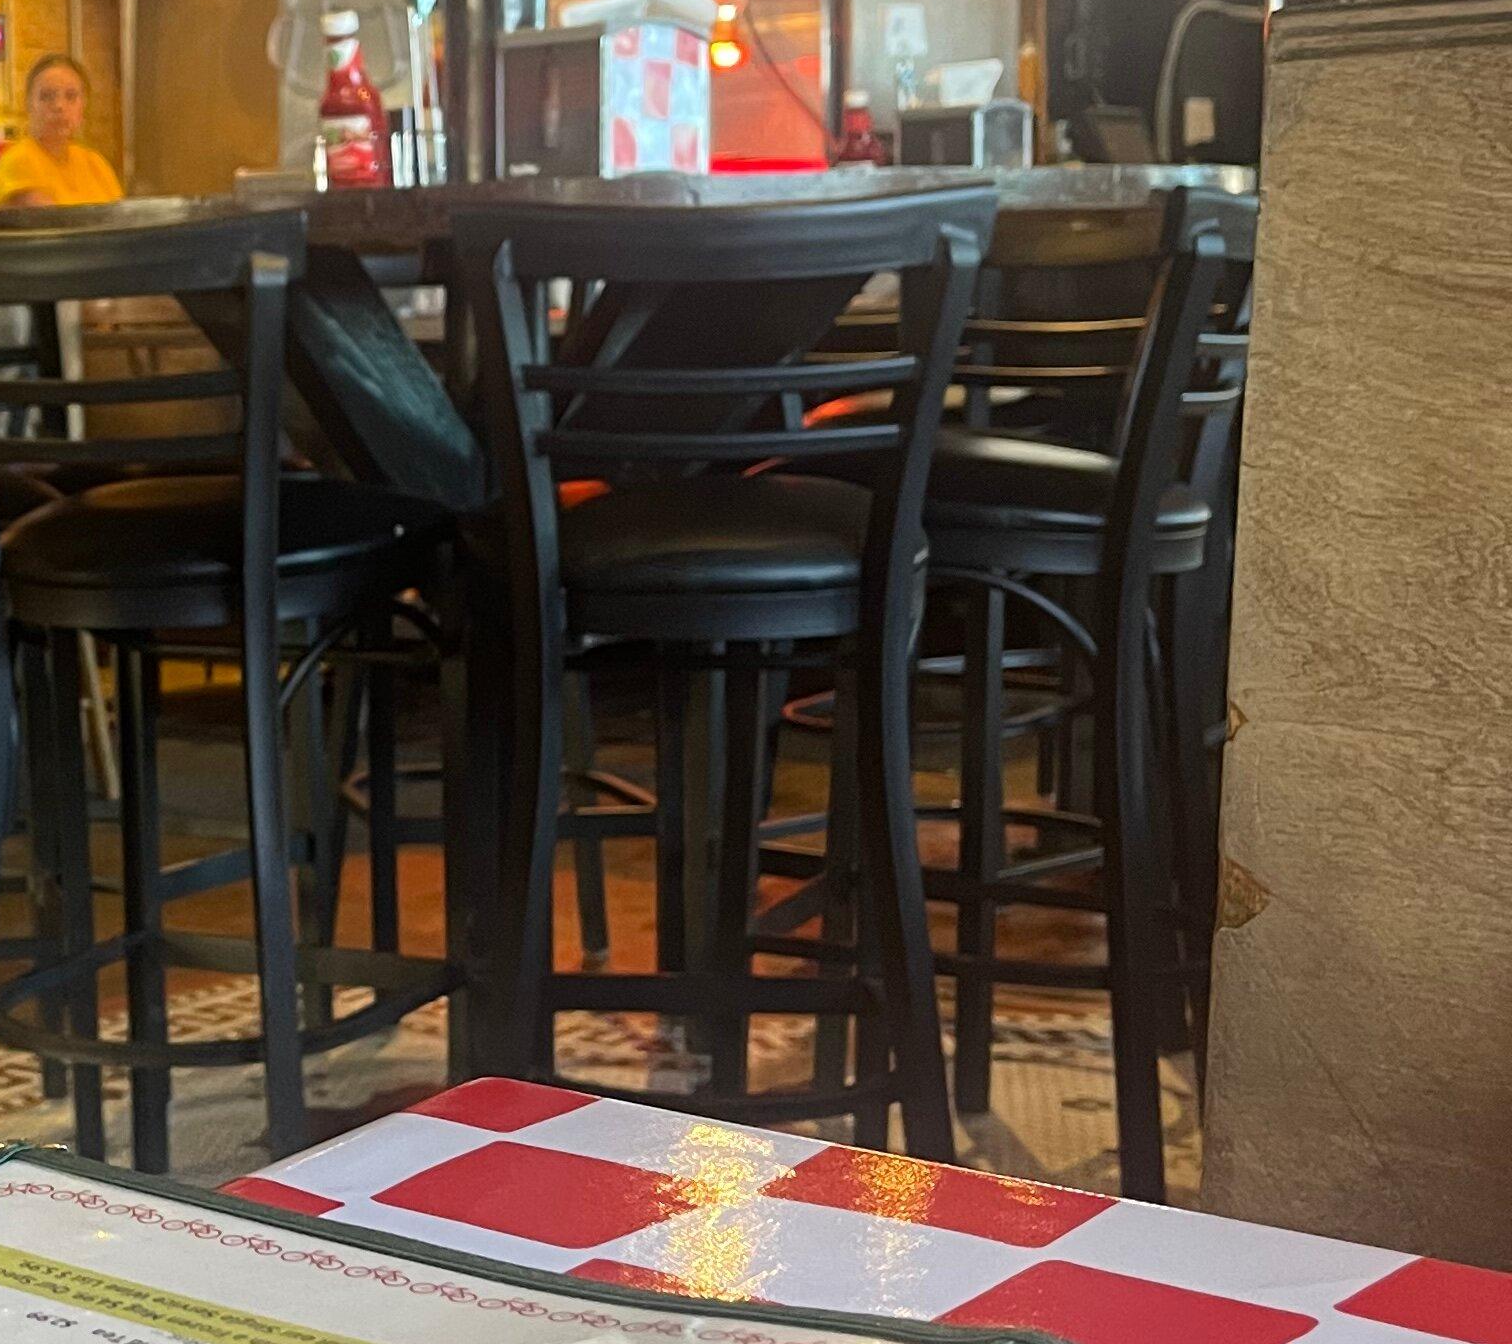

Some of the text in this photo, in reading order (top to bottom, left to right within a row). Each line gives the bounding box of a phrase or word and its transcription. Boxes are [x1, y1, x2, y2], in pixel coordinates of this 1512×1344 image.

[33, 1280, 71, 1295] Our
[69, 1273, 106, 1289] List
[103, 1282, 151, 1301] Wine
[122, 1303, 165, 1321] Mug
[151, 1296, 220, 1319] Service
[26, 1312, 78, 1328] $2.99
[165, 1316, 232, 1339] Frozen
[91, 1328, 126, 1344] Tea
[278, 1329, 317, 1342] our
